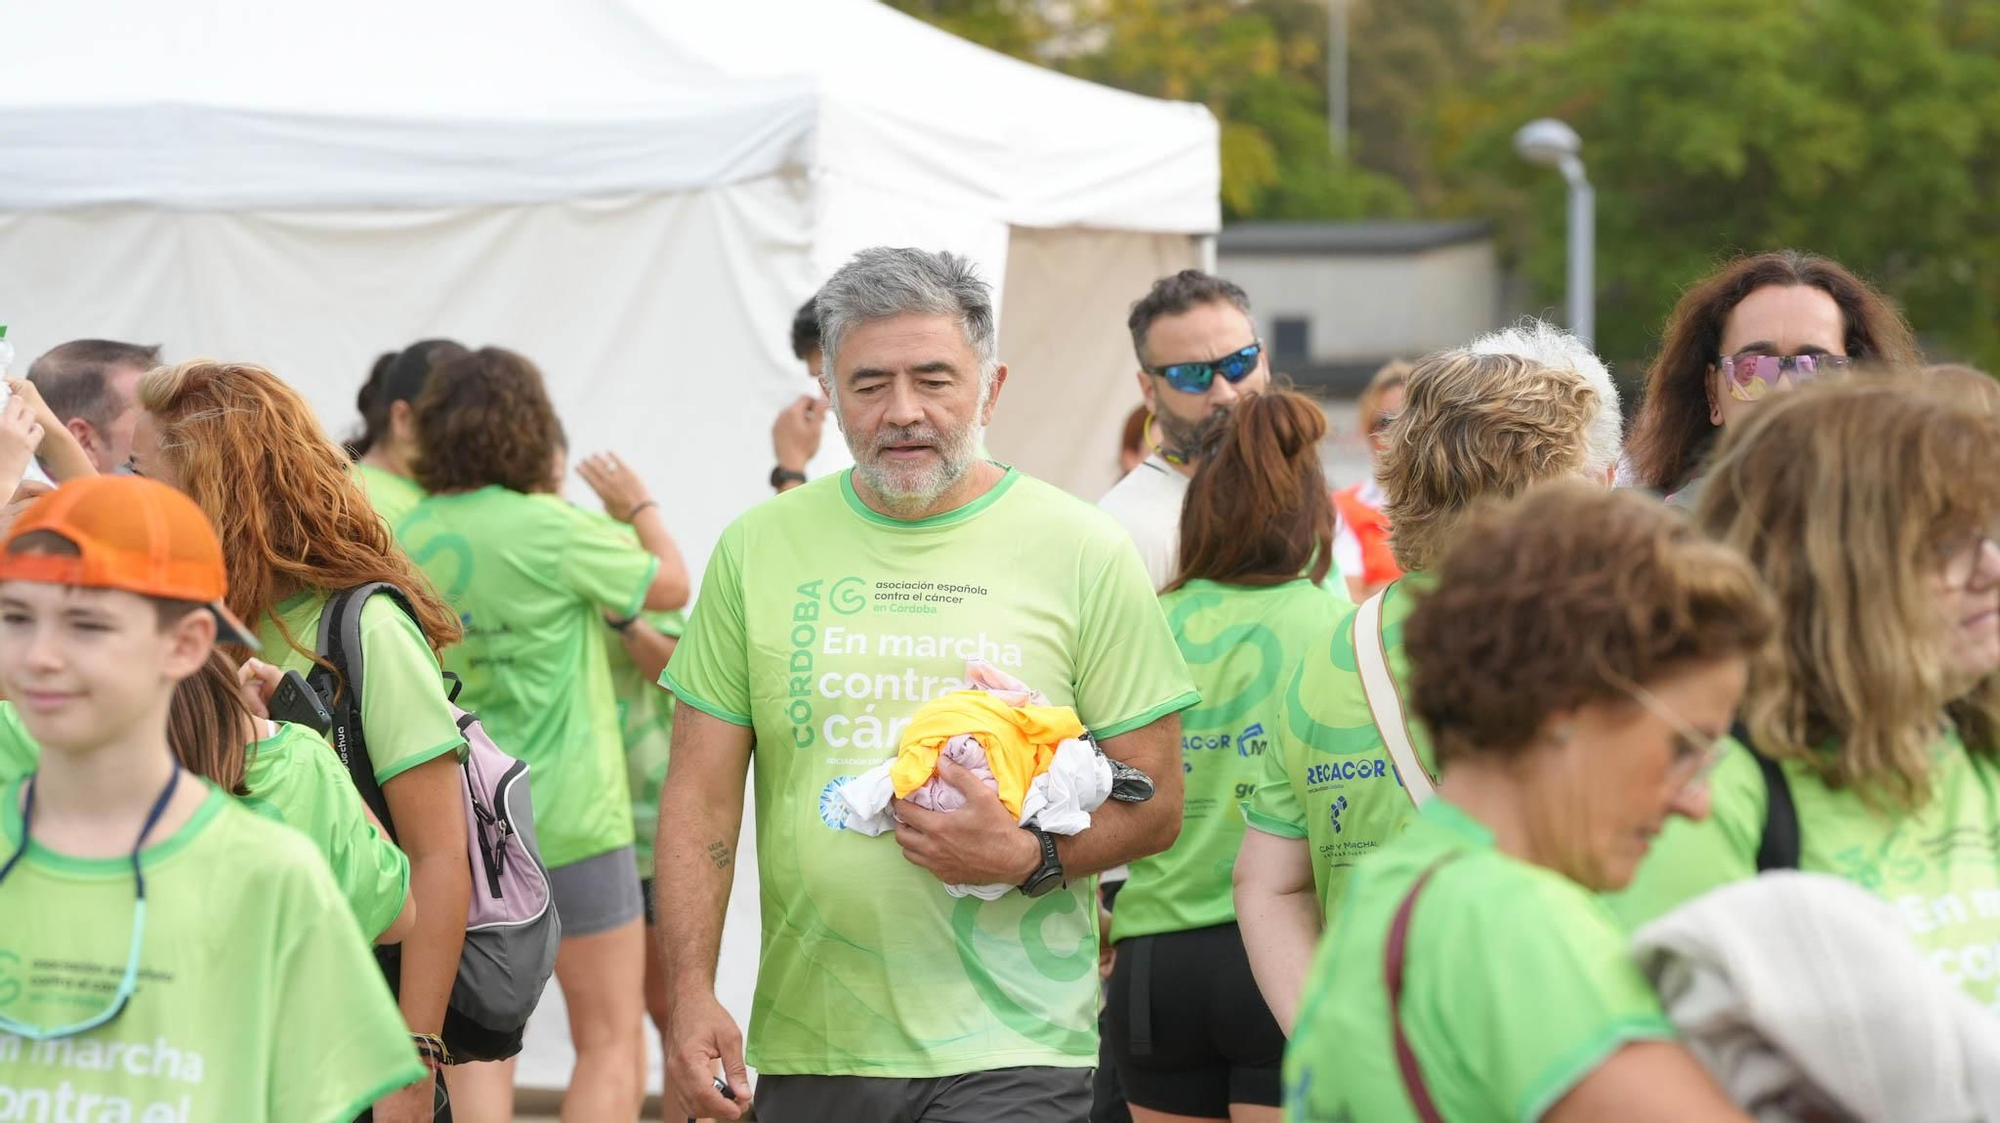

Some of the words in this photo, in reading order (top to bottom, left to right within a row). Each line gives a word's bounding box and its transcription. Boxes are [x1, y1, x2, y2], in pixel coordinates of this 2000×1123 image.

[874, 592, 910, 601] contra
[913, 592, 922, 601] el
[925, 592, 964, 604] cáncer
[876, 580, 934, 590] asociación
[937, 582, 988, 596] española
[889, 603, 938, 614] Córdoba
[785, 578, 824, 748] CÓRDOBA
[822, 626, 867, 655] En
[878, 631, 1022, 668] marcha
[818, 668, 965, 701] contra
[337, 726, 351, 771] uechua
[1307, 759, 1386, 786] RECACOR
[31, 1035, 204, 1085] marcha
